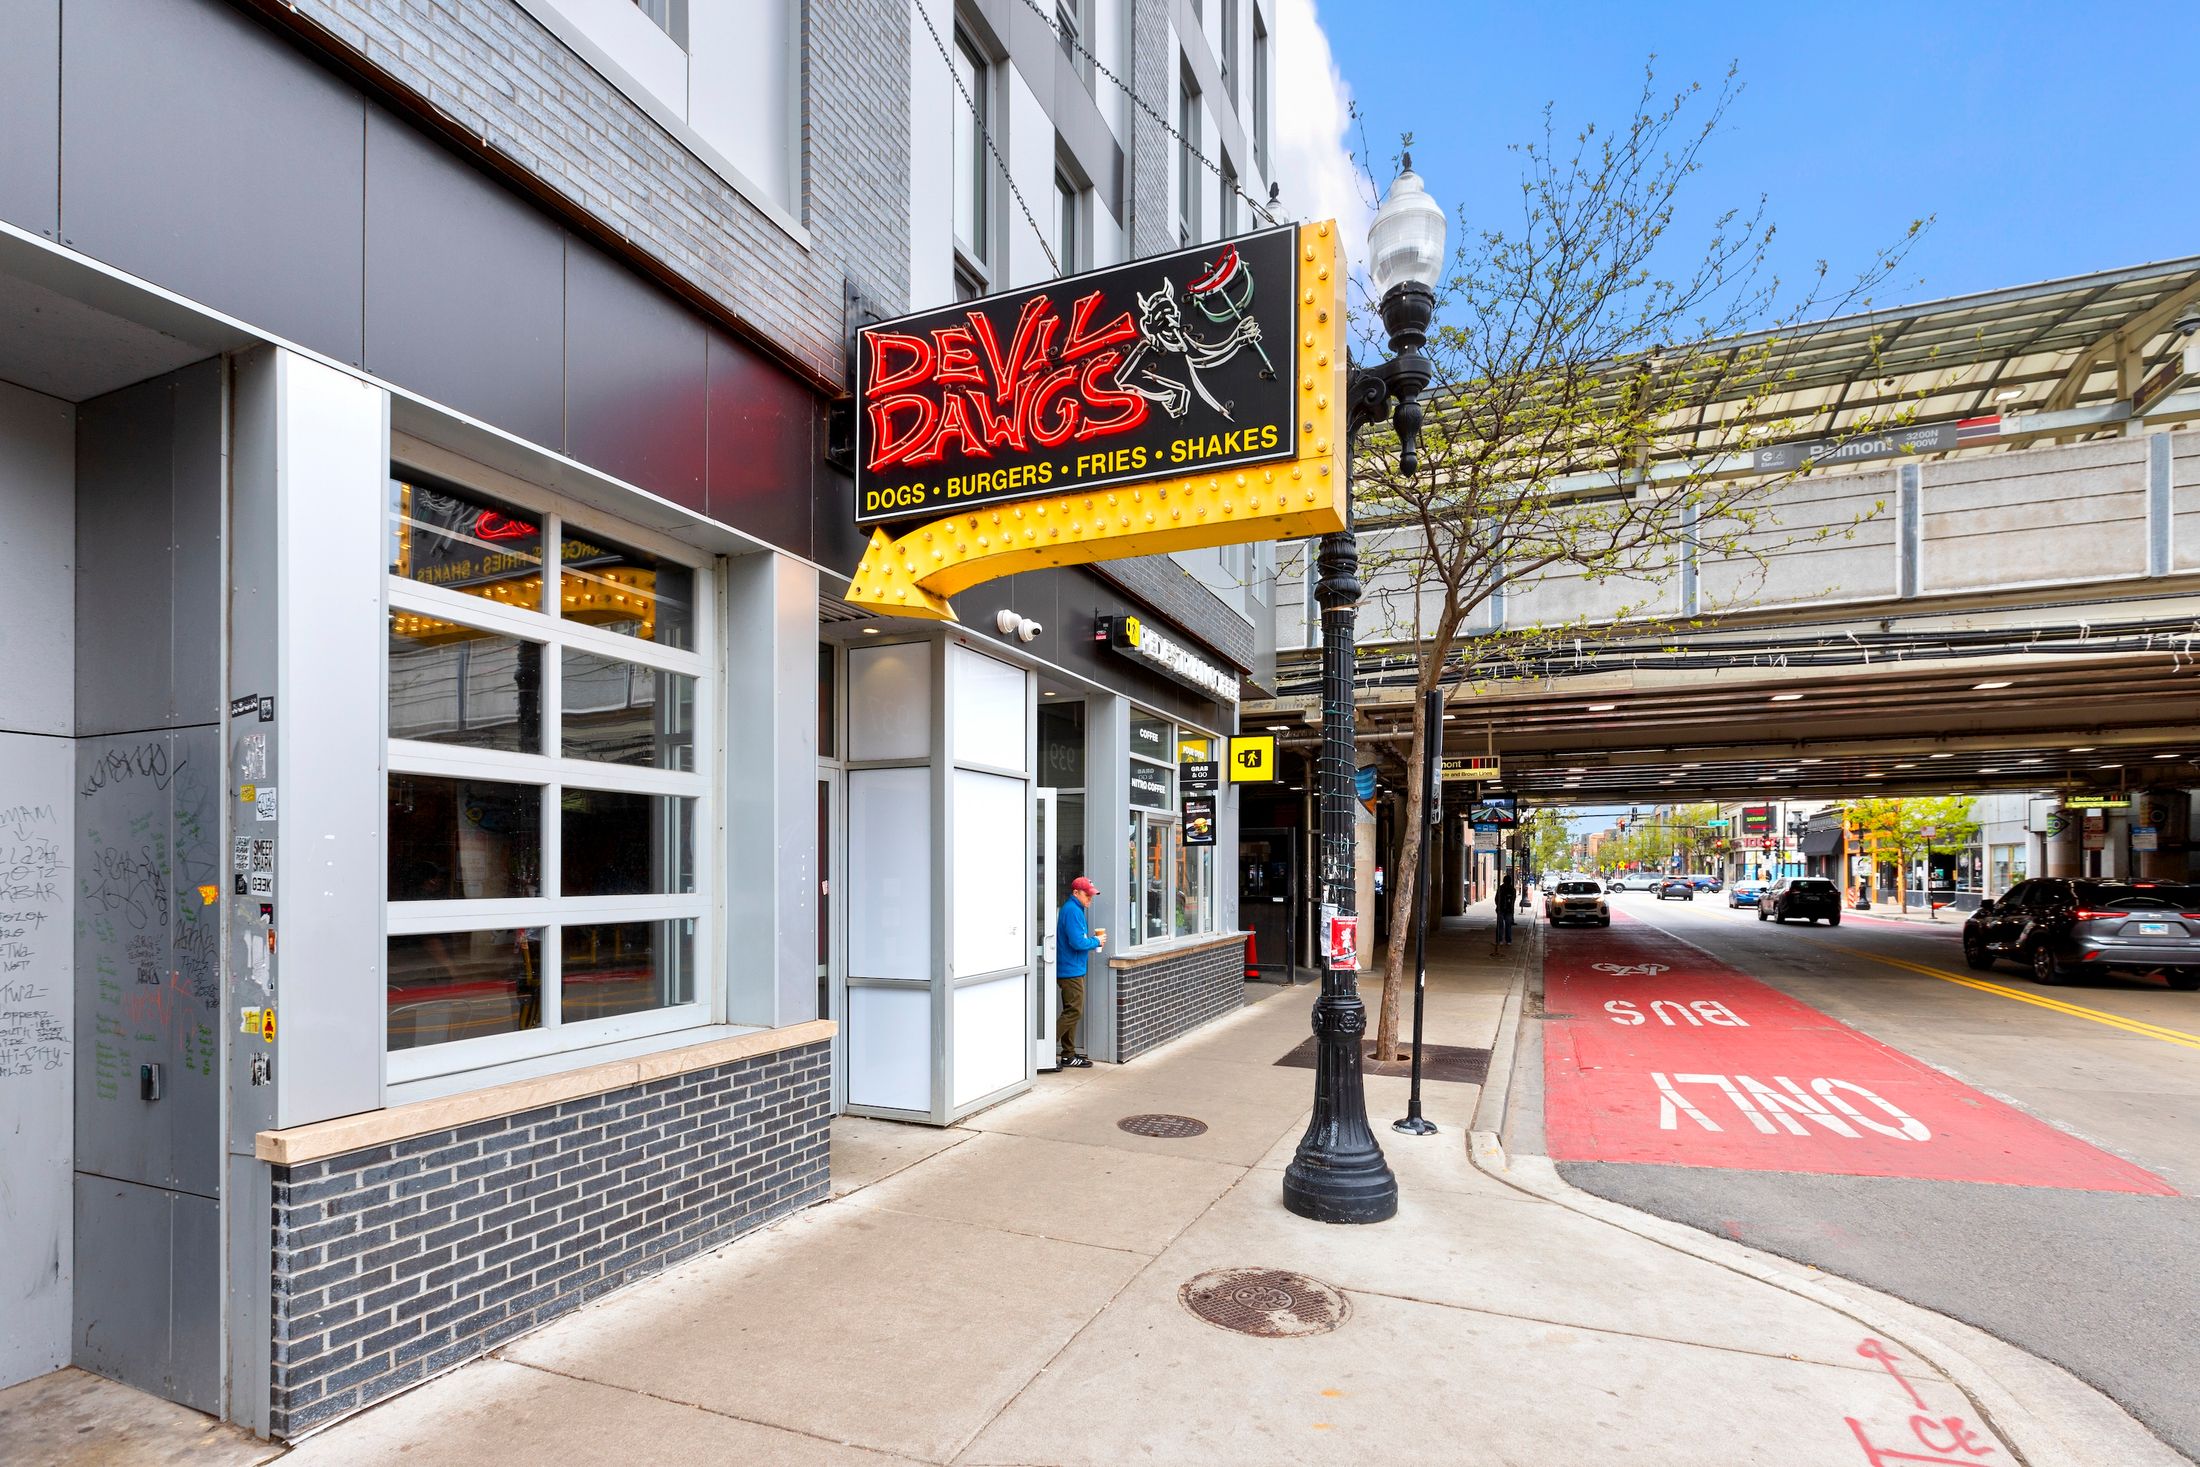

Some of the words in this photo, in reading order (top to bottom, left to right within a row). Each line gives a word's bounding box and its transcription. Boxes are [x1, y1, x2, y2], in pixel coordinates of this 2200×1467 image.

[865, 290, 1136, 403] DEVIL
[866, 348, 1152, 474] DAWGS
[1906, 429, 1939, 441] 3200N
[866, 483, 925, 511] DOGS
[947, 462, 1053, 499] BURGERS
[1077, 446, 1147, 477] FRIES
[1170, 424, 1279, 462] SHAKES
[1761, 460, 1785, 468] Elevator
[1139, 728, 1159, 743] COFFEE
[1131, 778, 1148, 789] NITRO
[1147, 781, 1166, 794] COFFEE
[253, 839, 273, 856] SMEER
[253, 856, 273, 873] SHARK
[252, 877, 272, 892] GEEK
[1604, 1000, 1751, 1027] BUS
[1650, 1072, 1932, 1142] ONLY
